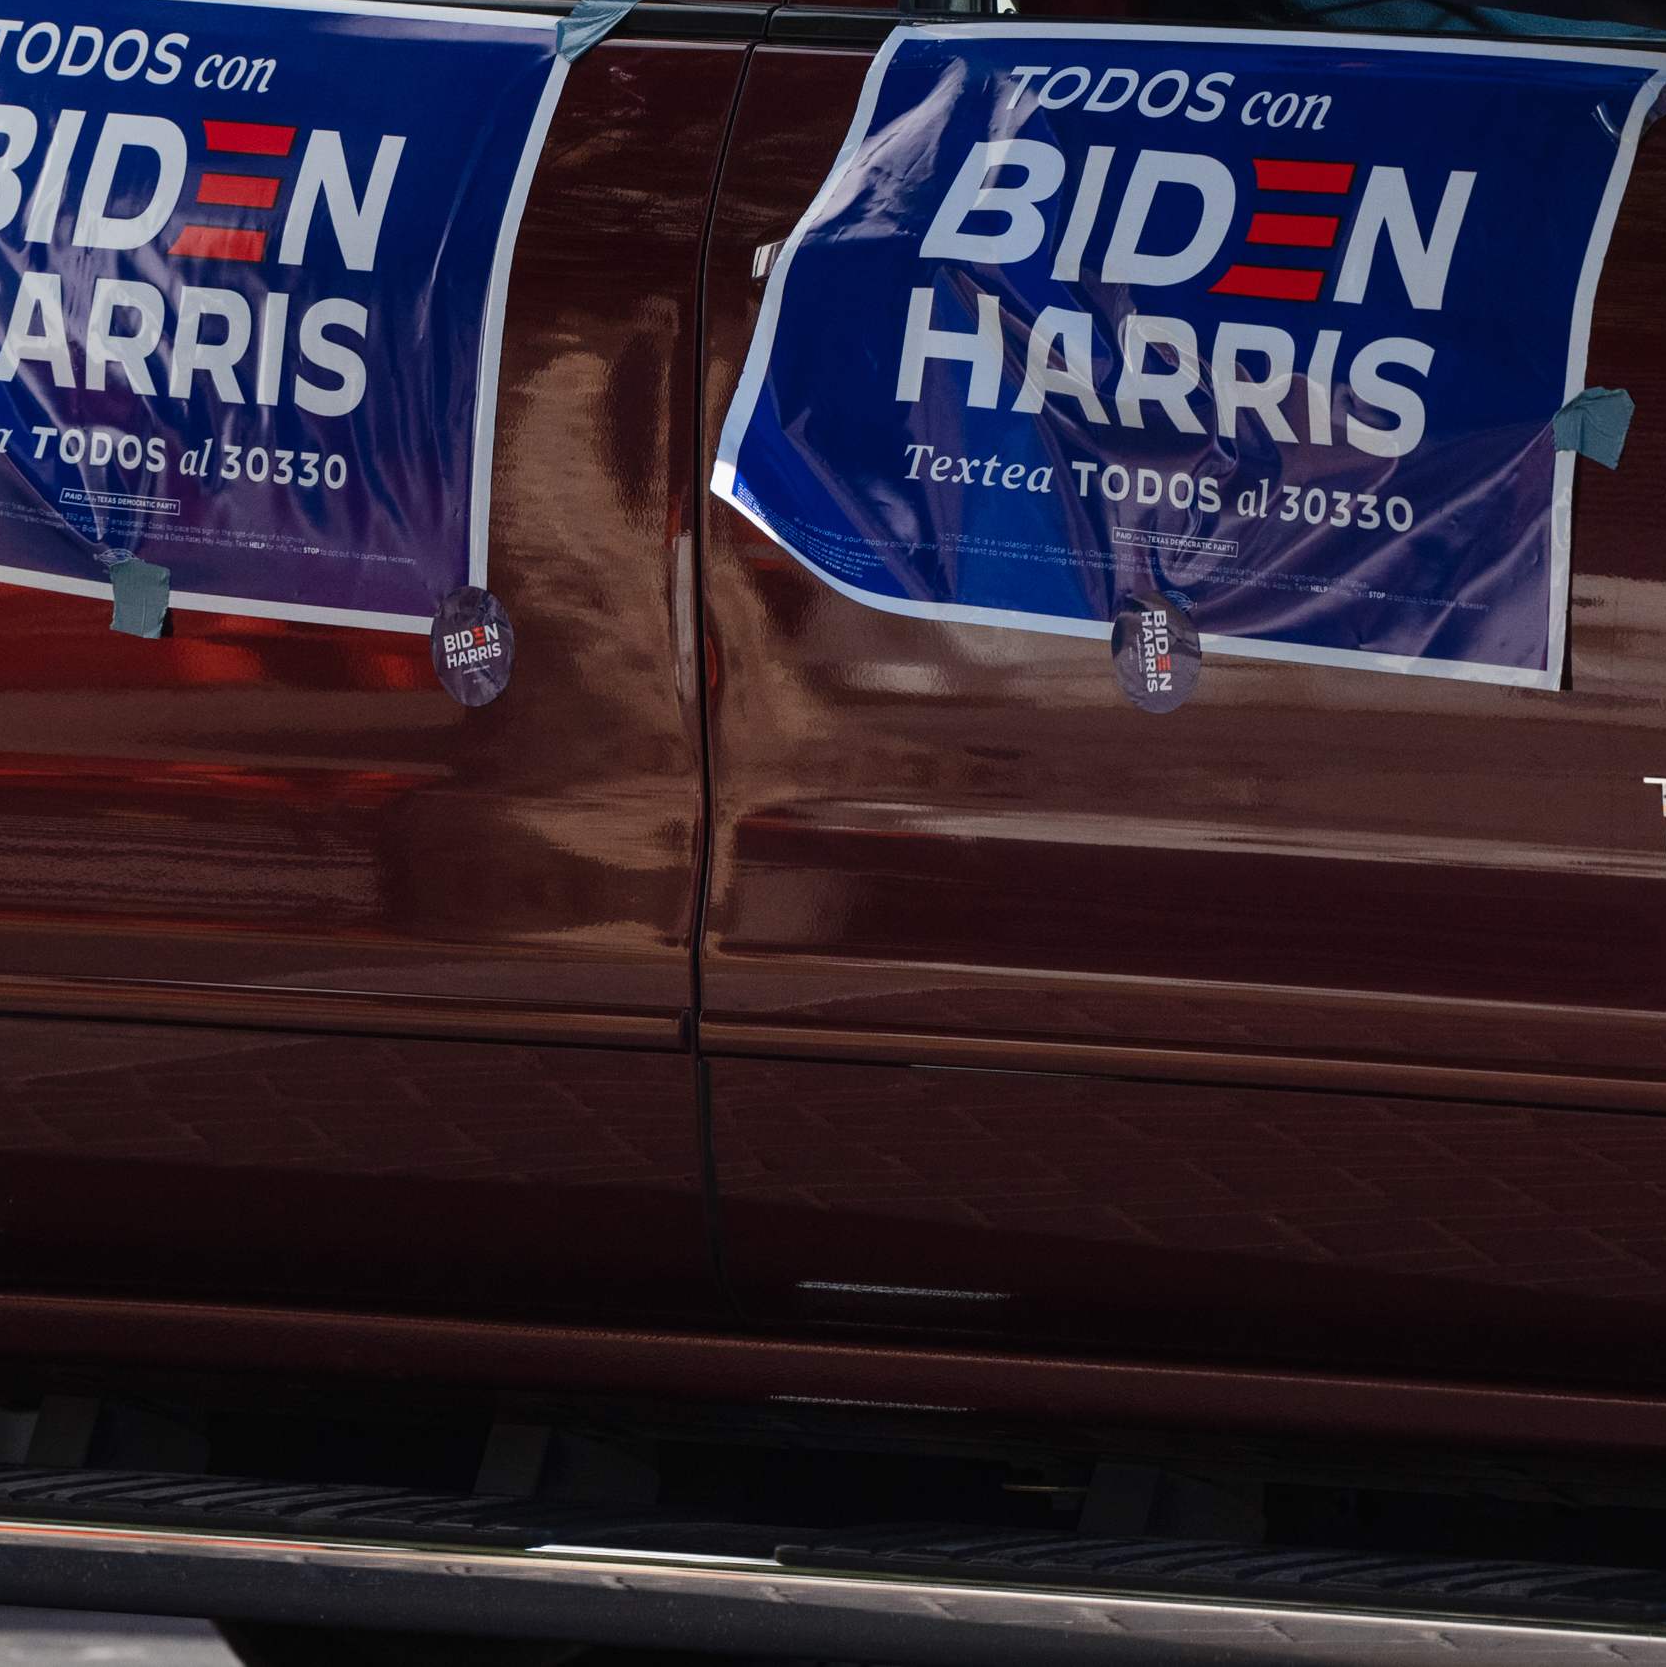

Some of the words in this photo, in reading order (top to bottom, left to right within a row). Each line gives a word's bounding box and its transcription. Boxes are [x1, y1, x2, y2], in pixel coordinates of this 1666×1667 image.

[194, 51, 277, 93] con
[1006, 65, 1236, 123] TODOS
[1240, 90, 1332, 131] con
[919, 139, 1477, 311] BIDEN
[895, 287, 1435, 458] HARRIS
[31, 426, 167, 472] TODOS
[180, 437, 214, 478] al
[220, 444, 348, 490] 30330
[64, 492, 82, 500] PAID
[97, 495, 117, 505] TEXAS
[117, 498, 156, 509] DEMOCRATIC
[156, 502, 178, 511] PARTY
[904, 444, 1054, 493] Textea
[1072, 462, 1222, 513] TODOS
[1237, 478, 1269, 518] al
[1280, 485, 1414, 532] 30330
[303, 546, 319, 555] STOP
[1116, 531, 1132, 540] PAID
[1148, 535, 1169, 545] TEXAS
[1170, 538, 1212, 550] DEMOCRATIC
[1213, 543, 1235, 552] PARTY
[1369, 591, 1385, 599] STOP
[443, 623, 499, 653] BIDEN
[446, 642, 502, 669] HARRIS
[1141, 611, 1158, 692] HARRIS
[1153, 610, 1172, 691] BIDEN
